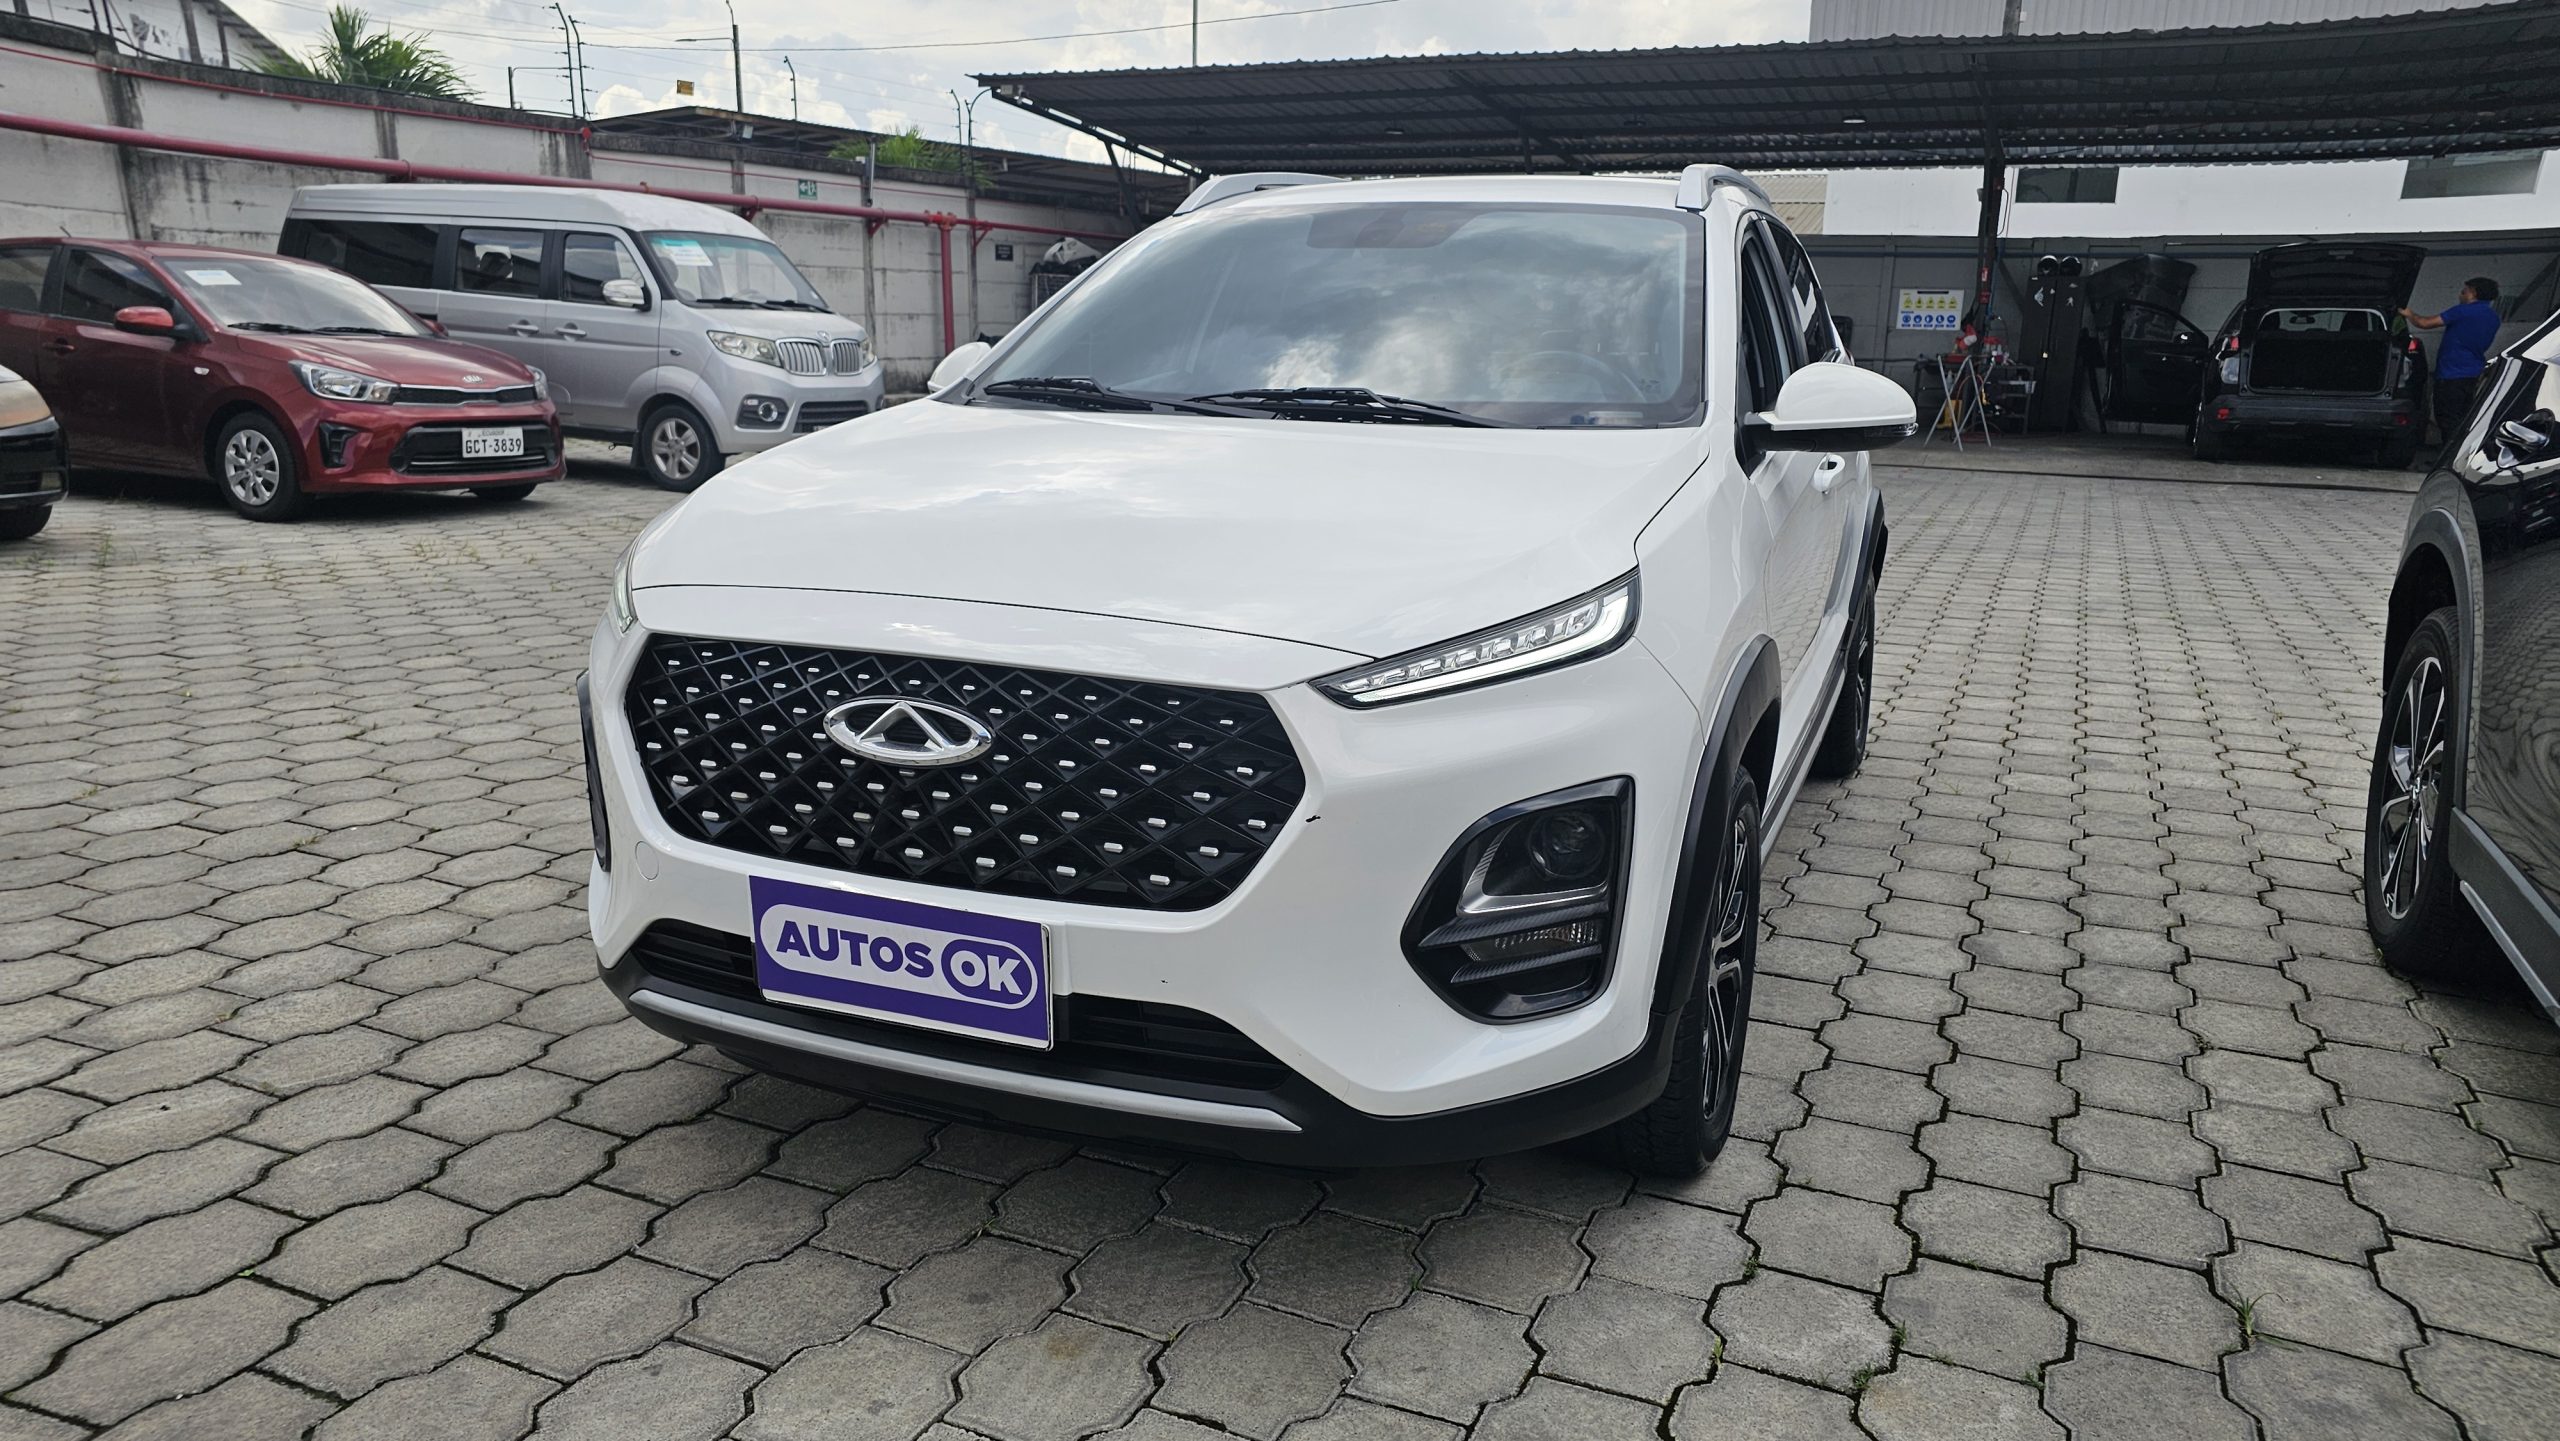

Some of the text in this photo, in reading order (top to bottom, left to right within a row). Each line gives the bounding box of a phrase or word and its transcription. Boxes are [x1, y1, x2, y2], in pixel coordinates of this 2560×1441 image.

[465, 438, 521, 454] GCT-3839
[776, 920, 1023, 996] AUTOS OK
